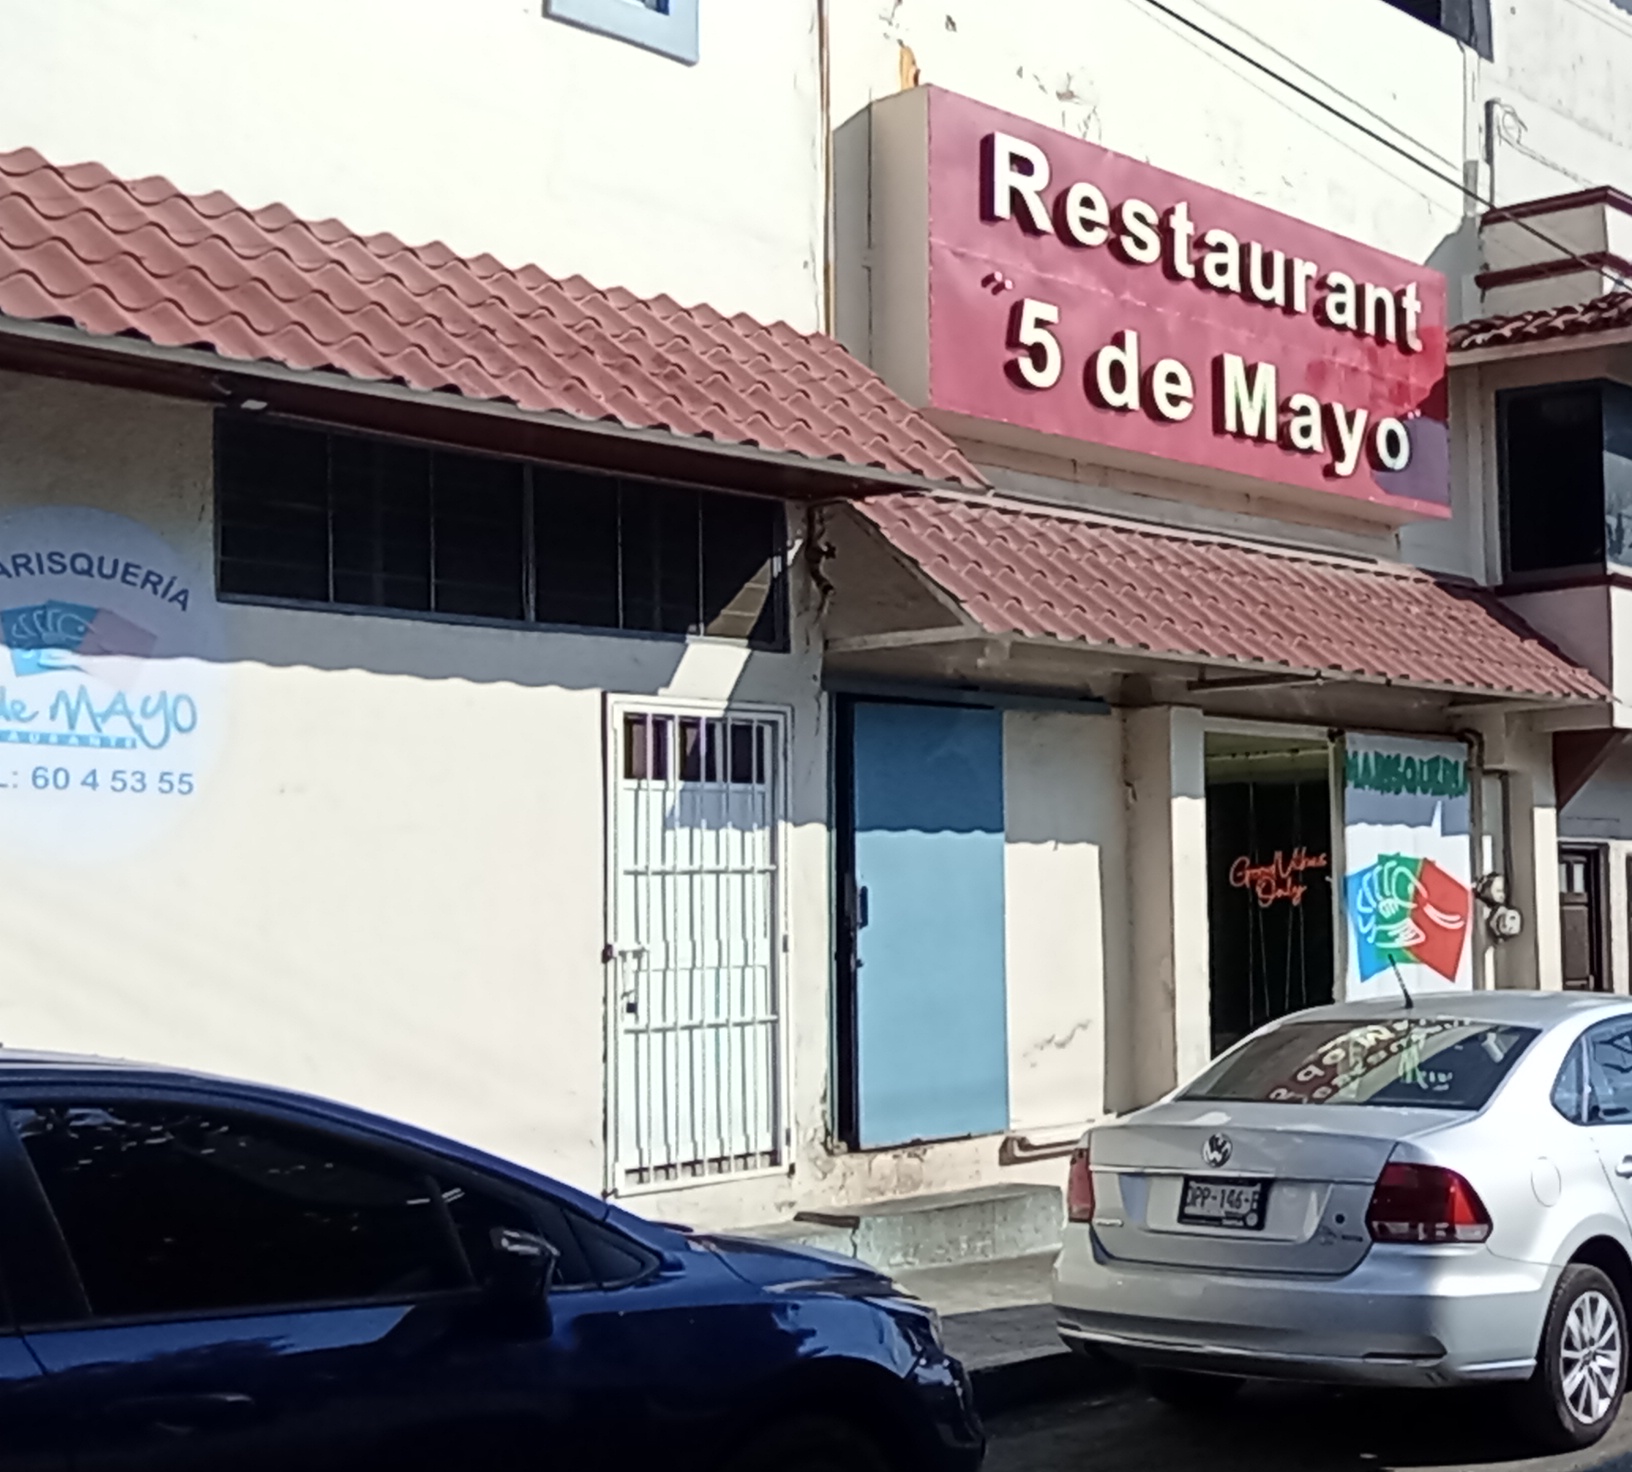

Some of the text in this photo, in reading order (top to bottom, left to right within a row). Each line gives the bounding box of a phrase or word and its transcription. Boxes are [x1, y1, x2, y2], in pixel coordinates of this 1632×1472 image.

[981, 130, 1422, 352] Restaurant
[1084, 329, 1195, 422] de
[31, 765, 70, 791] 60
[80, 767, 100, 791] 4
[110, 769, 147, 793] 53
[158, 771, 195, 796] 55
[1229, 850, 1277, 889] Good
[1255, 875, 1308, 908] Only
